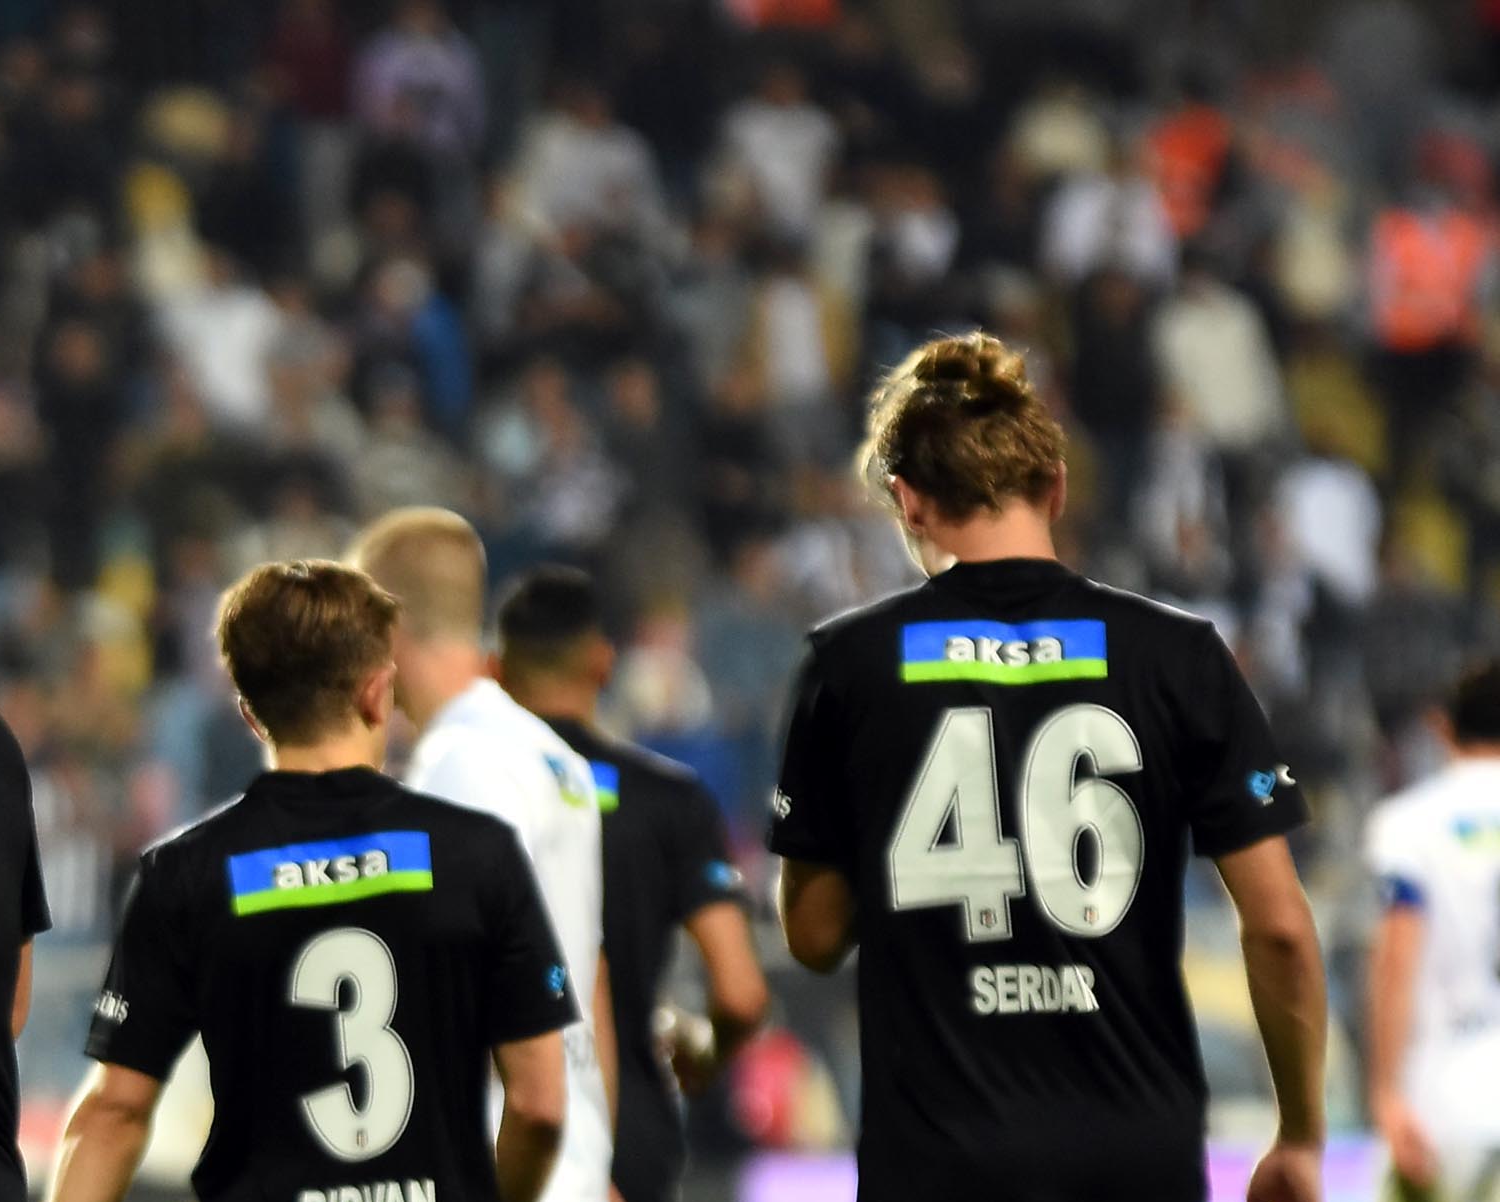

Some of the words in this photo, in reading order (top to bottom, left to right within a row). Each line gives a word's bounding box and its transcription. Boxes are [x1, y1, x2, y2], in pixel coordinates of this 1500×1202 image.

[944, 635, 1064, 666] aksa
[888, 703, 1145, 943] 46
[273, 849, 389, 890] aksa
[971, 965, 1101, 1015] SERDAR
[290, 927, 415, 1162] 3
